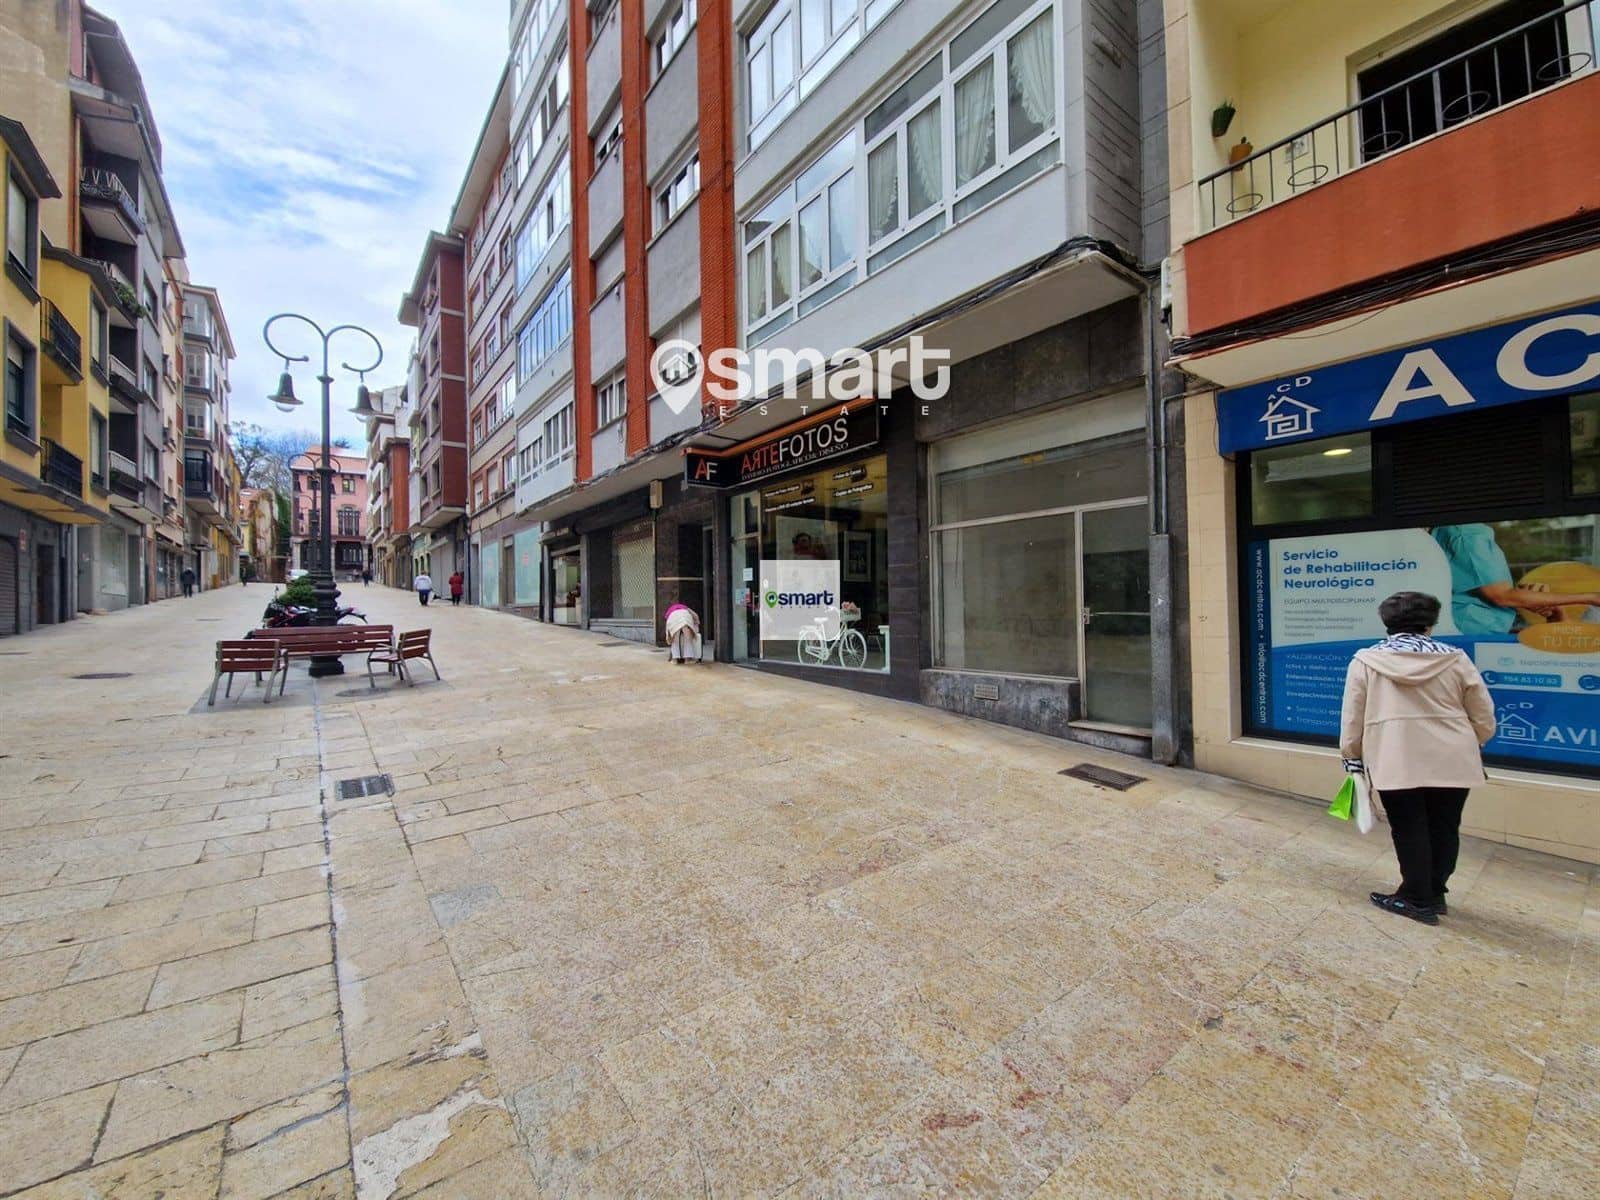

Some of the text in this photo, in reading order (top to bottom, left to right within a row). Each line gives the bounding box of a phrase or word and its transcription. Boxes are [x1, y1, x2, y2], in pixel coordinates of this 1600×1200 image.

[741, 417, 848, 475] ARTEFOTOS
[695, 458, 718, 480] AF
[1283, 549, 1338, 560] Servicio
[1283, 558, 1417, 575] de Rehabilitación
[1284, 577, 1375, 589] Neurológica
[1543, 725, 1597, 747] AVI
